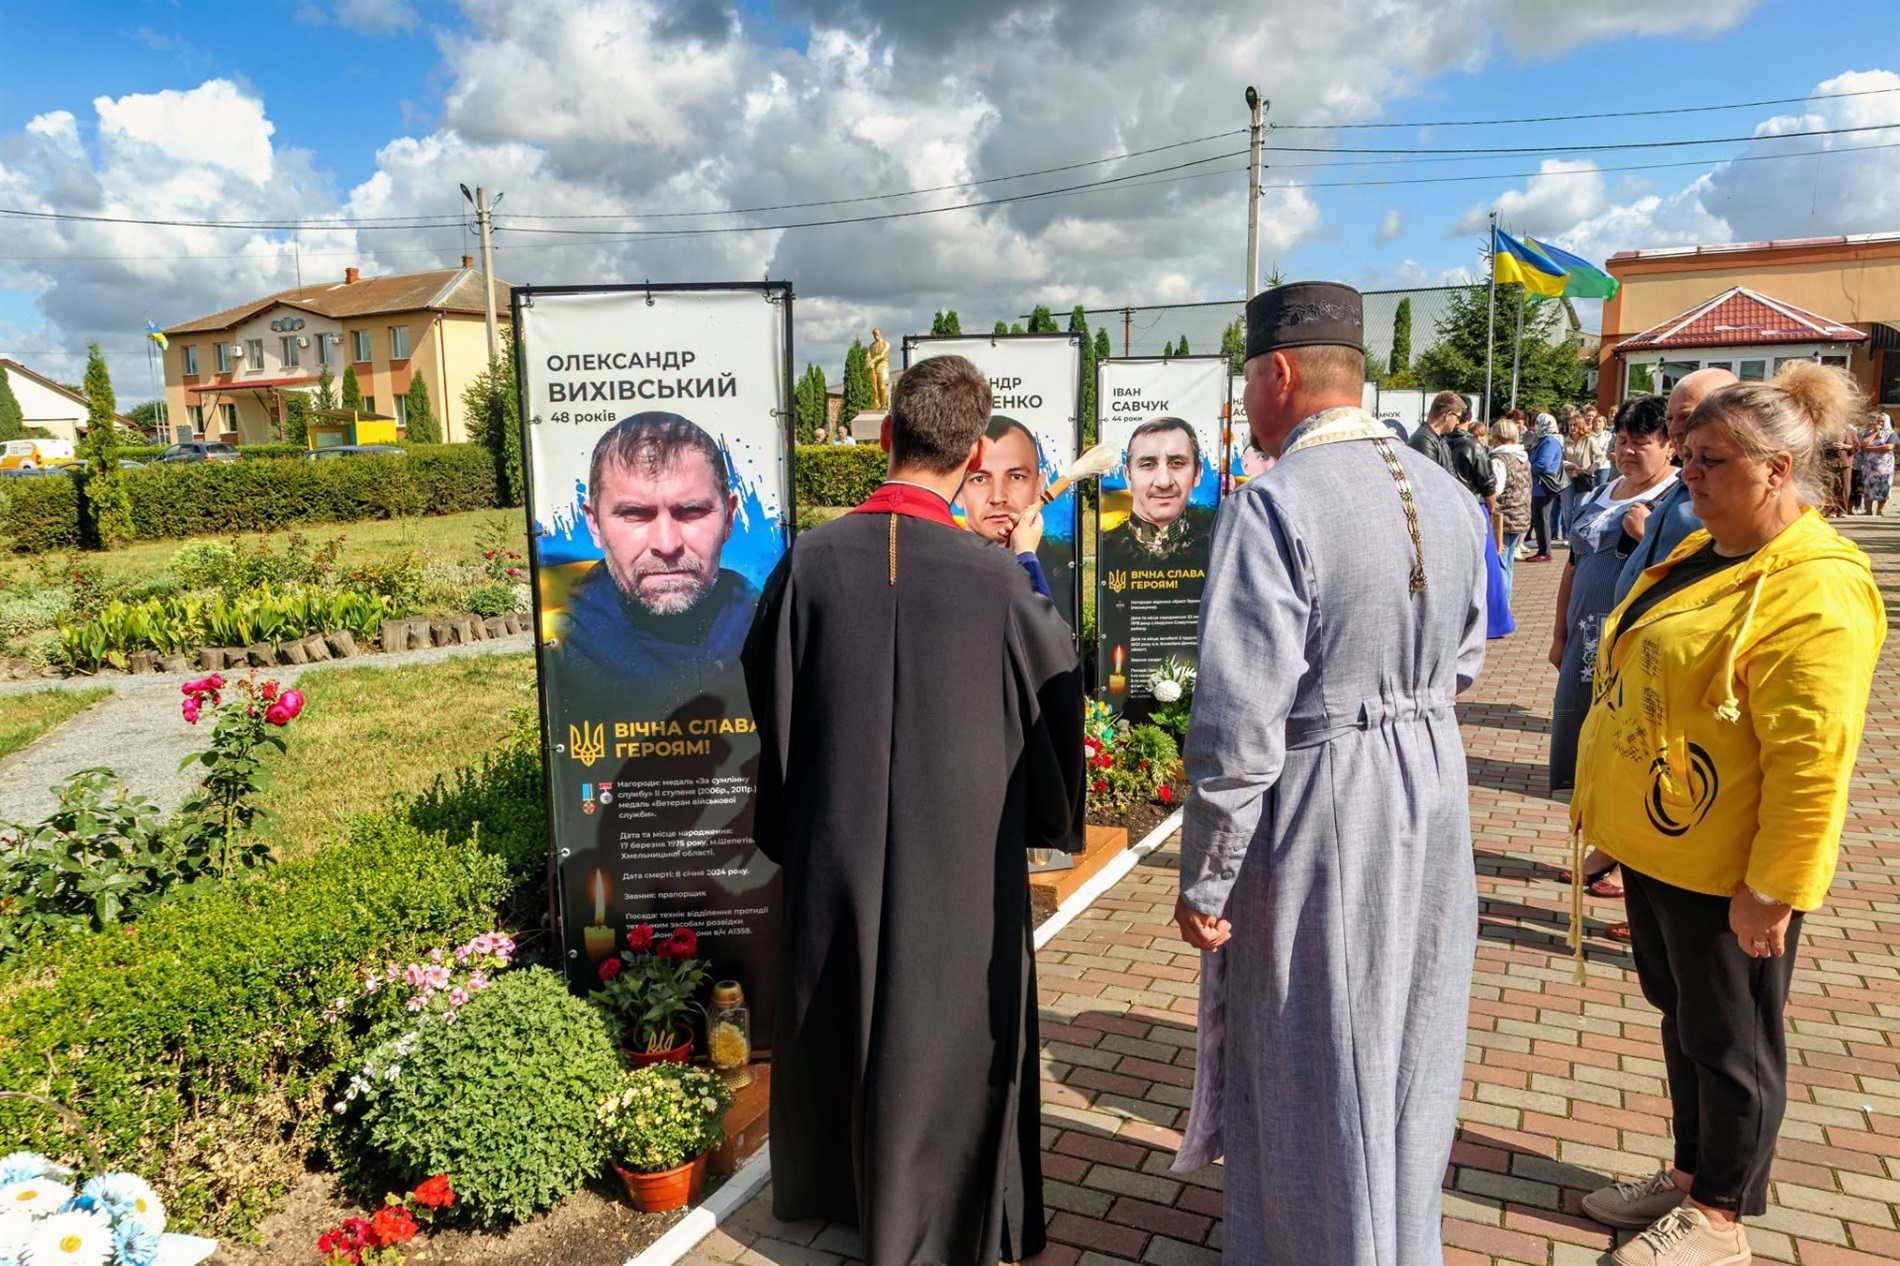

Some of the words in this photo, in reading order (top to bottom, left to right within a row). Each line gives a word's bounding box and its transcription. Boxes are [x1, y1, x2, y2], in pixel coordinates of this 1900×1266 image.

[547, 351, 696, 371] ОЛЕКСАНДР
[548, 372, 737, 403] ВИХІВСЬКИЙ
[989, 377, 1022, 391] НДР
[1113, 388, 1141, 397] ІВАН
[992, 395, 1043, 409] ЕНКО
[1112, 400, 1169, 412] САВЧУК
[550, 411, 570, 423] 48
[574, 409, 616, 425] років
[1131, 570, 1165, 579] ВІЧНА
[1167, 569, 1205, 578] СЛАВА
[1131, 580, 1178, 590] ГЕРОЯМ!
[615, 720, 683, 738] ВІЧНА
[616, 739, 711, 758] ГЕРОЯМ!
[617, 779, 661, 789] Нагороди:
[662, 778, 694, 787] медаль
[695, 777, 710, 785] «За
[711, 775, 750, 785] сумлінну
[618, 789, 653, 799] службу»
[661, 789, 696, 798] ступеня
[698, 787, 730, 797] (2006р.,
[618, 801, 650, 809] медаль
[651, 799, 691, 808] «Ветеран
[692, 796, 737, 806] військової
[619, 811, 657, 820] служби».
[620, 832, 640, 841] Дата
[652, 830, 677, 839] місце
[678, 828, 734, 838] народження:
[630, 840, 666, 850] березня
[667, 839, 685, 847] 1975
[621, 850, 681, 860] Хмельницької
[682, 848, 716, 858] області.
[622, 872, 643, 881] Дата
[644, 871, 675, 880] смерті:
[682, 869, 705, 878] січня
[706, 868, 726, 876] 2024
[728, 868, 750, 877] року.
[658, 890, 707, 899] прапорщик
[625, 912, 658, 921] Посада:
[659, 910, 685, 919] технік
[687, 908, 733, 918] відділення
[734, 906, 769, 916] протидії
[670, 920, 705, 928] засобам
[706, 918, 743, 927] розвідки
